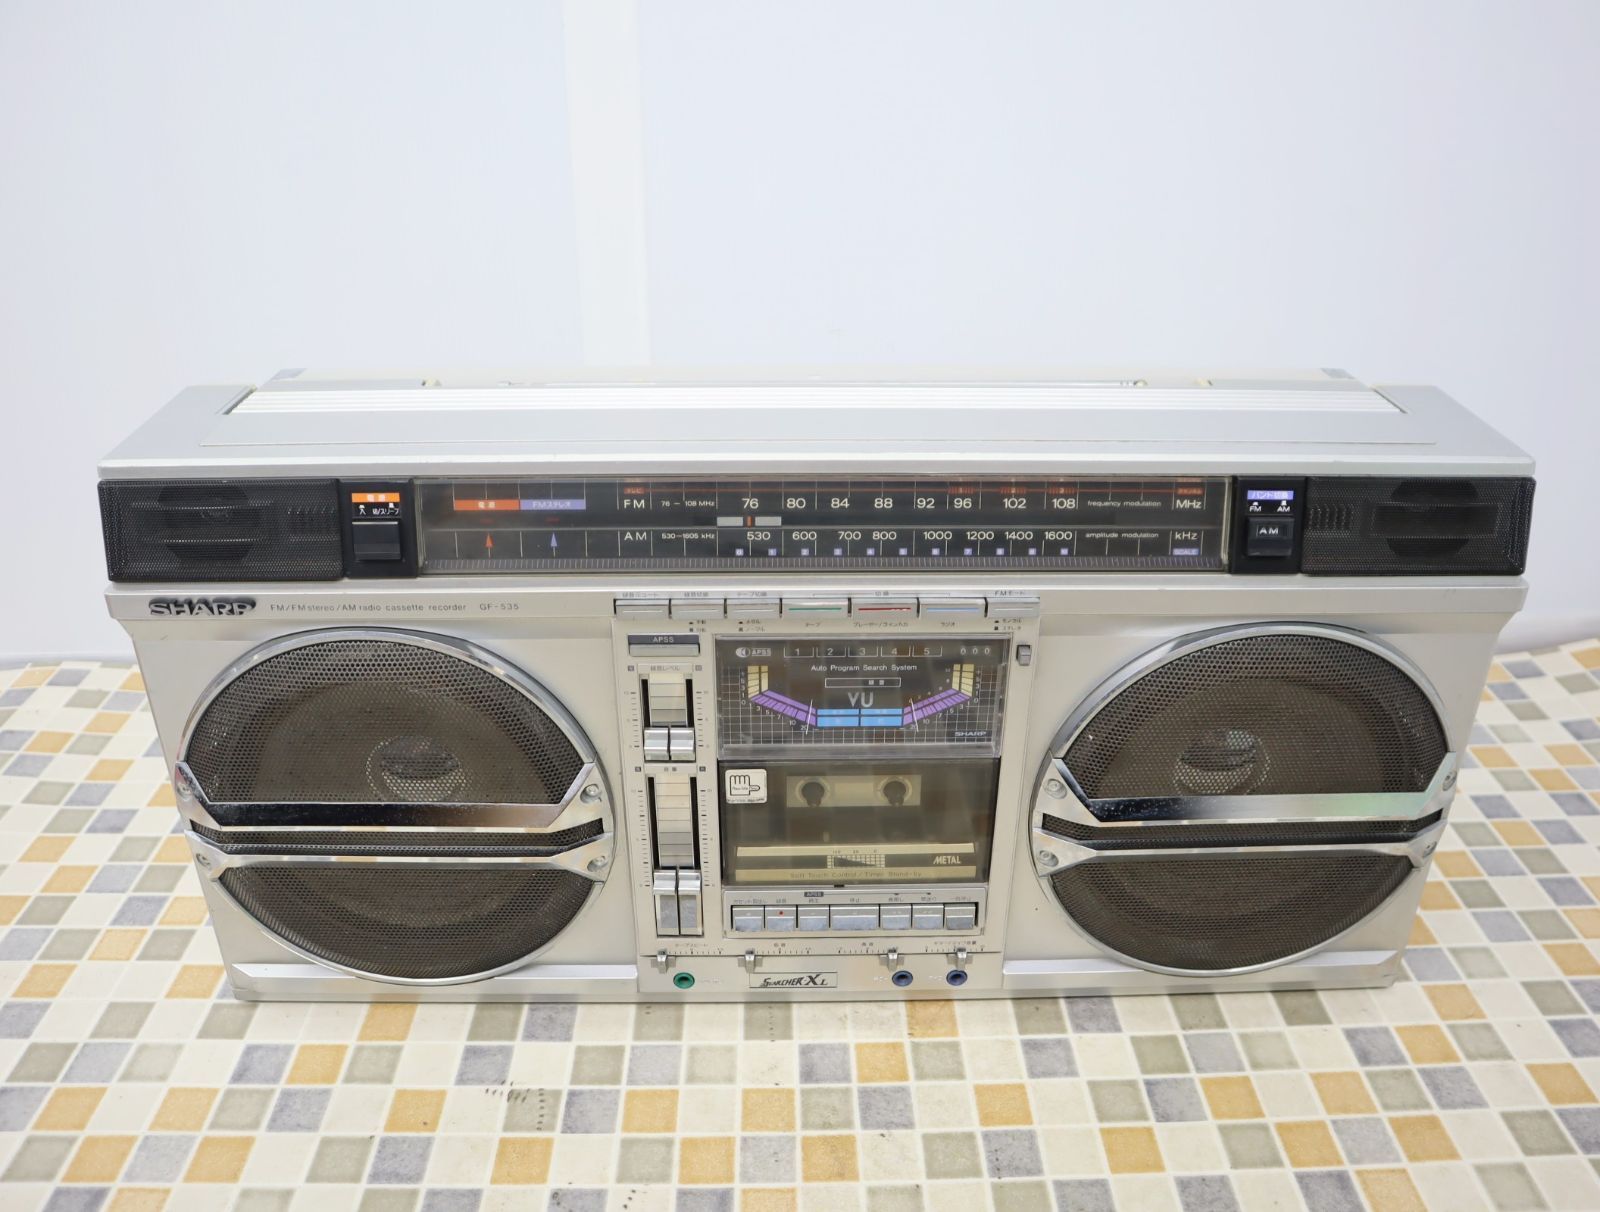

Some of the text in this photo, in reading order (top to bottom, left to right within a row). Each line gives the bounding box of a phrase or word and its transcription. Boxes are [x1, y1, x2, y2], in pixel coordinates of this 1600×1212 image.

[624, 500, 645, 509] FM
[742, 498, 1076, 509] 76 80 84 88 92 96 102 108
[1176, 499, 1201, 509] MHz
[746, 531, 1073, 540] 530 600 700 800 1000 1200 1400 1600
[1175, 531, 1197, 540] kHz
[1259, 527, 1279, 535] AM
[624, 532, 647, 541] AM
[149, 598, 256, 616] SHARP
[359, 603, 382, 611] radio
[386, 603, 424, 611] cassette
[428, 603, 467, 611] recorder
[652, 636, 675, 644] APSS
[795, 648, 800, 656] 1
[827, 648, 834, 656] 2
[859, 648, 866, 656] 3
[830, 665, 860, 674] Program
[891, 665, 917, 673] System
[848, 692, 874, 708] VU
[932, 855, 962, 865] METAL
